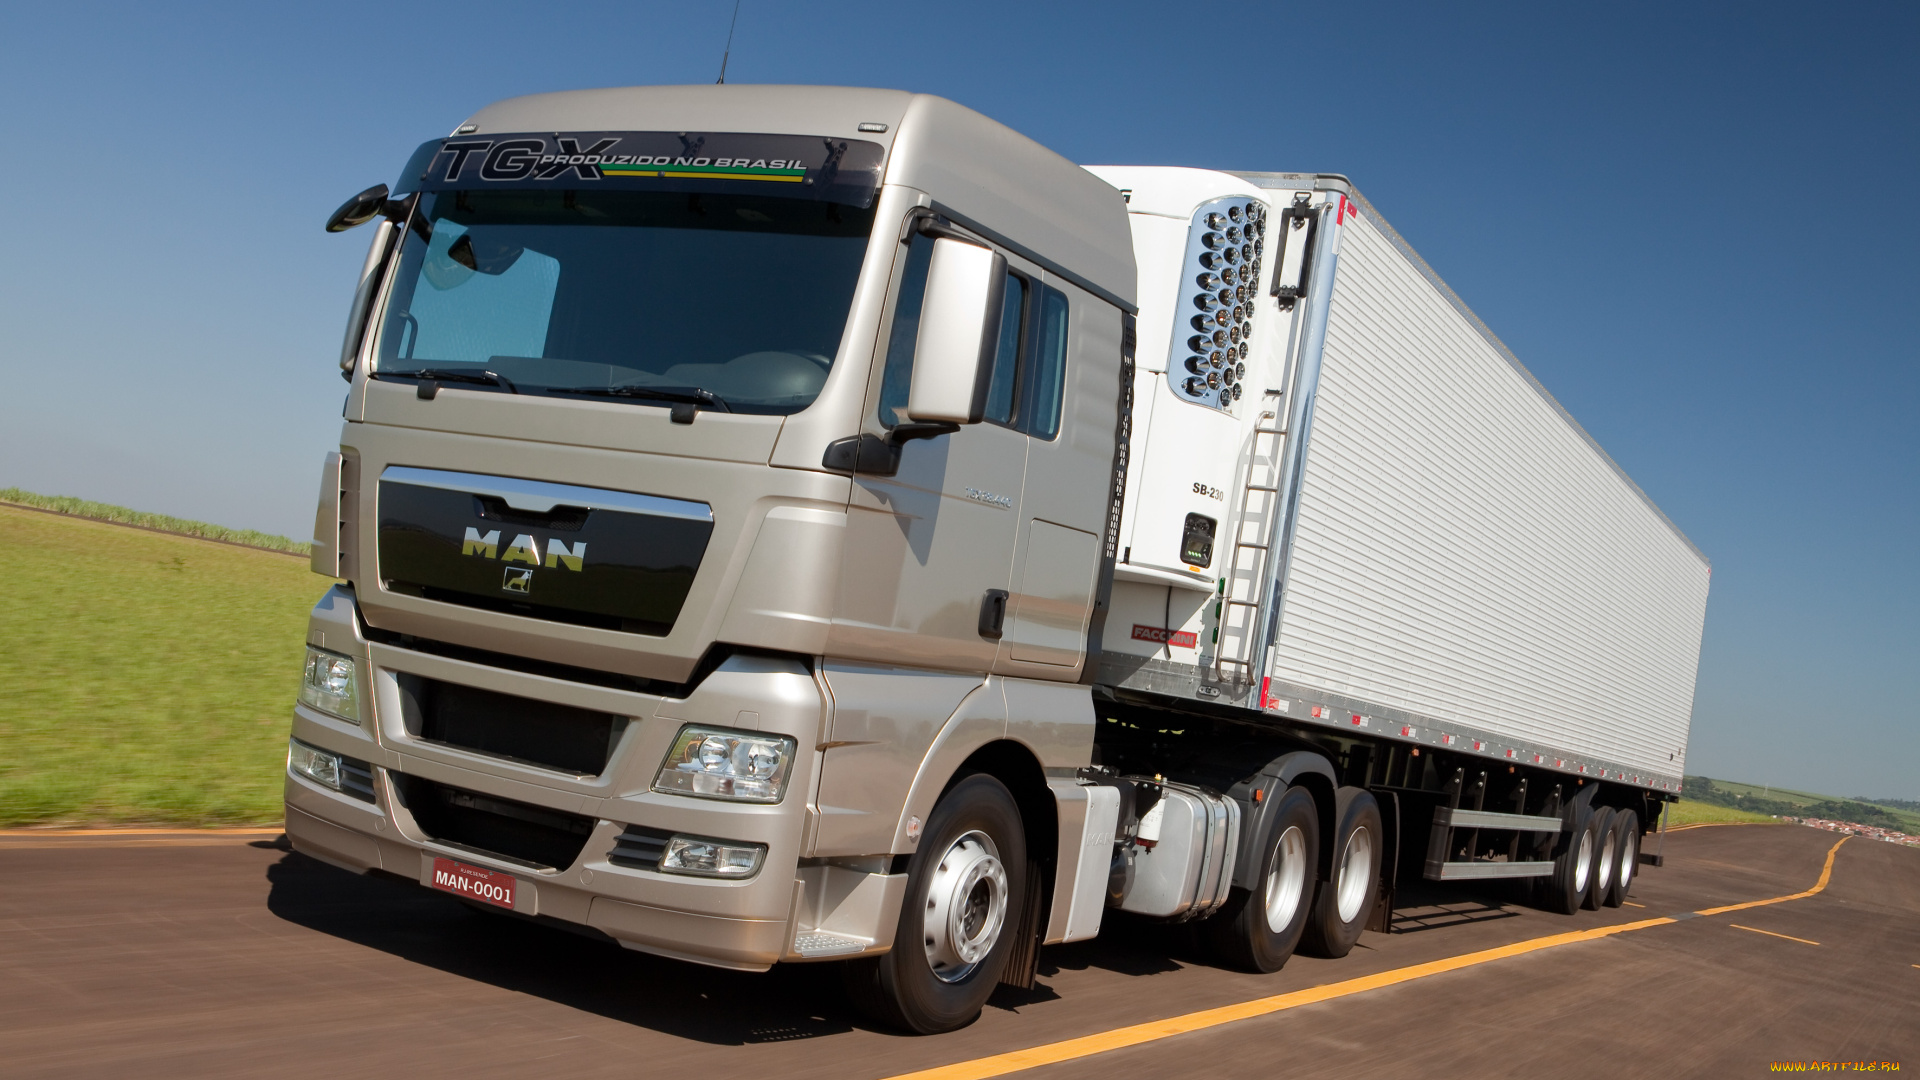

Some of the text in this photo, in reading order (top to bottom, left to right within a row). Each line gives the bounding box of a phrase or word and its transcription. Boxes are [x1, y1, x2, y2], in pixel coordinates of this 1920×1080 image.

[442, 138, 622, 182] TGX
[540, 154, 808, 170] PRODUZIDO NO BRASIL
[1192, 482, 1224, 502] SB-230
[462, 526, 587, 572] MAN
[1134, 626, 1195, 646] FACCHINI
[435, 870, 512, 903] MAN-0001
